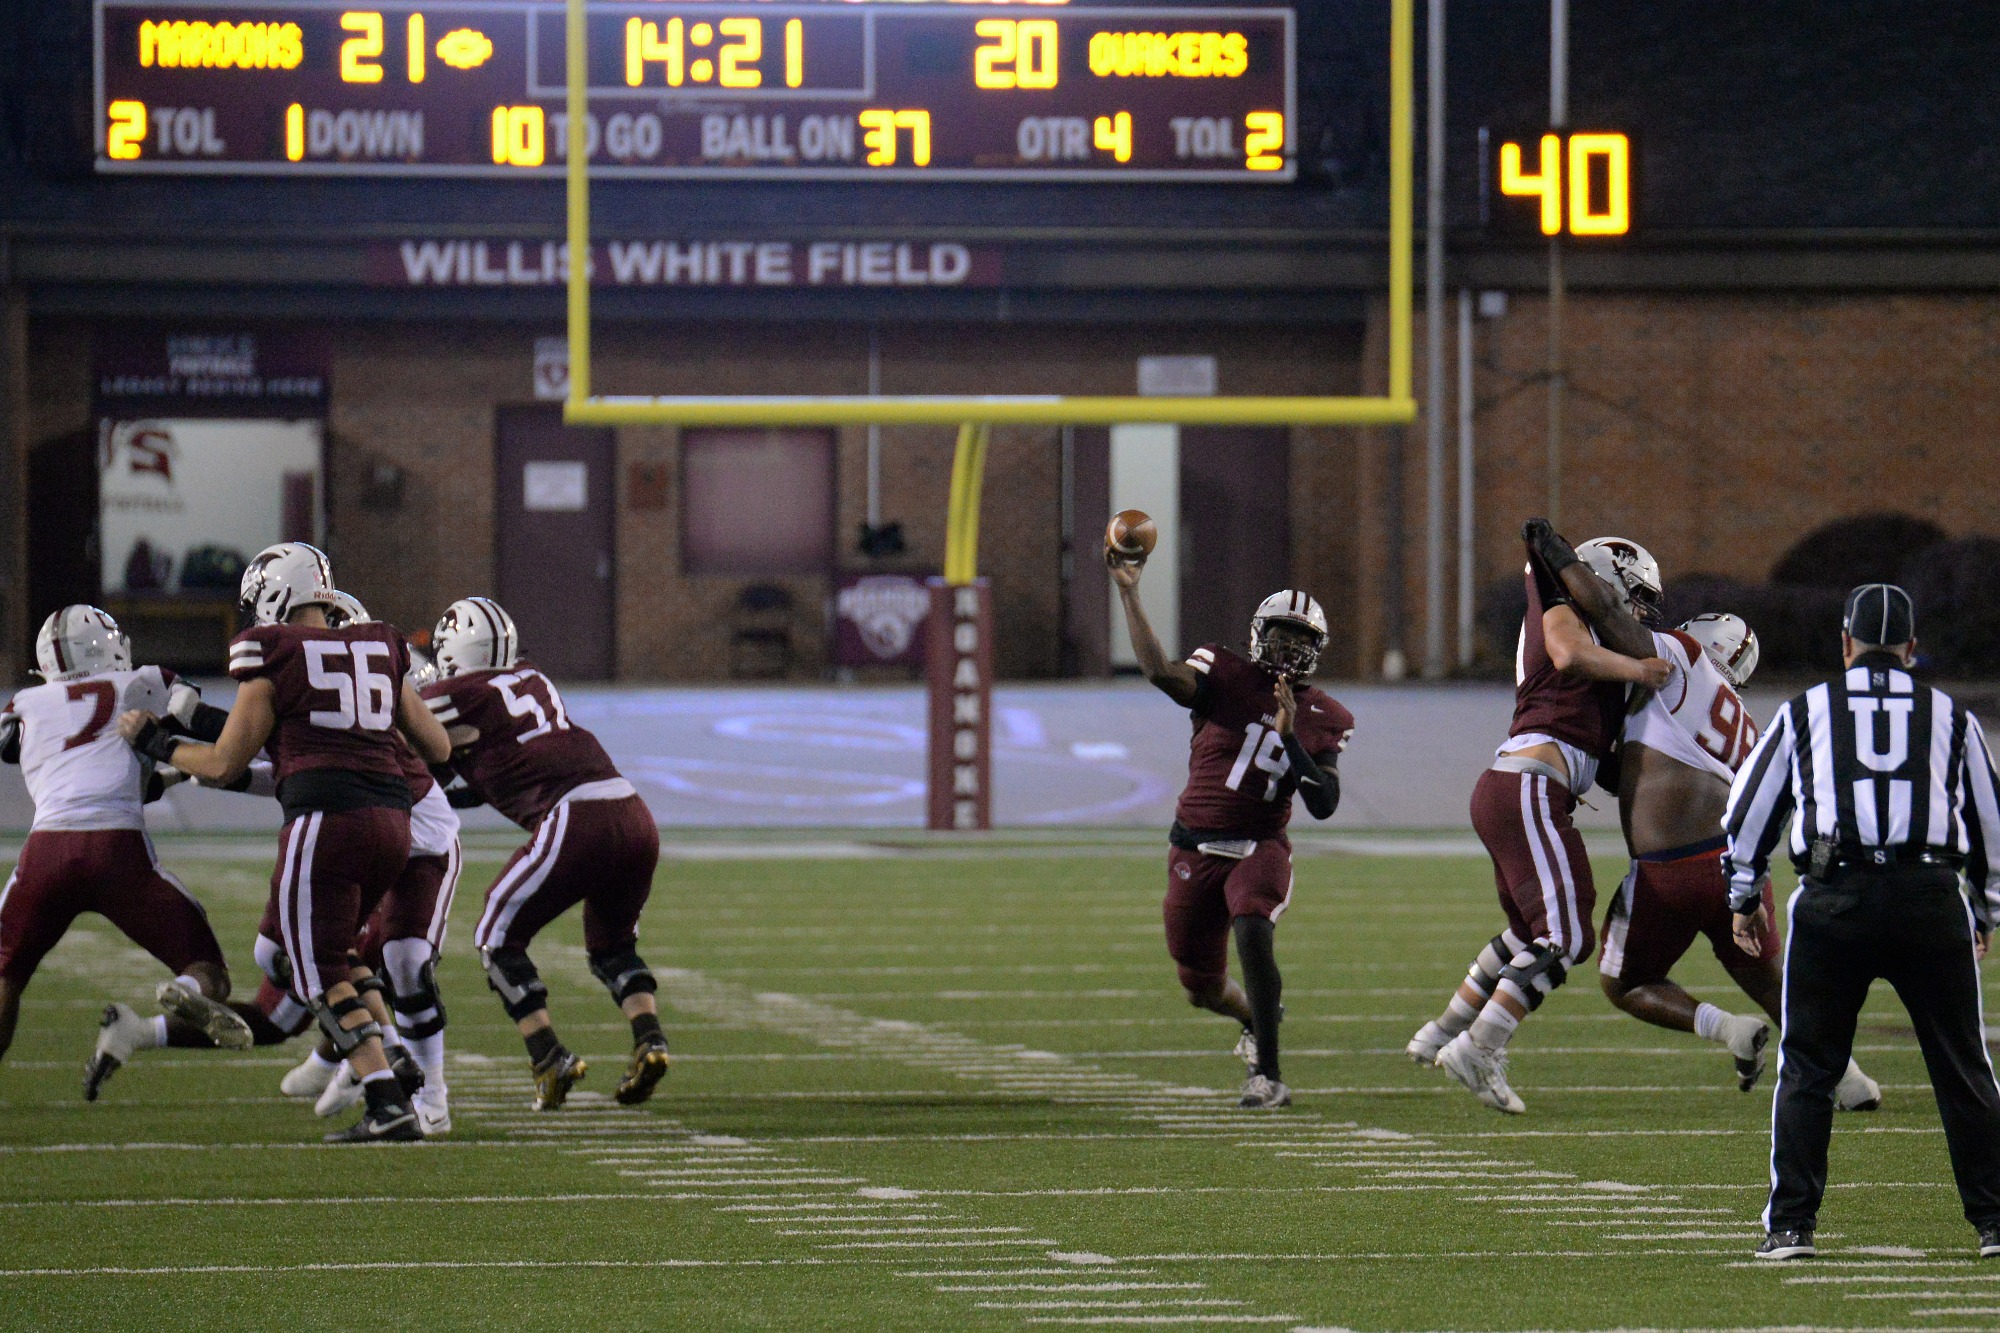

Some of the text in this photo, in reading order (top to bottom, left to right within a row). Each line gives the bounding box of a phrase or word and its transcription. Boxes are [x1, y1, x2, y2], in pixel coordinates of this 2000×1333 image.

[139, 20, 303, 70] MAROONS
[339, 11, 426, 84] 21
[625, 16, 803, 89] 14:21
[974, 18, 1059, 90] 20
[1088, 31, 1248, 78] QUAKERS
[108, 100, 225, 160] 2 TOL
[286, 103, 424, 162] 1 DOWN
[491, 106, 545, 167] 10
[606, 111, 662, 158] GO
[702, 109, 931, 167] BALL ON 37
[1093, 111, 1133, 163] 4
[1169, 111, 1284, 171] TOL 2
[1501, 134, 1629, 236] 40
[608, 243, 792, 284] WHITE
[808, 243, 971, 284] FIELD
[302, 639, 394, 731] 56
[62, 680, 116, 752] 7
[1847, 696, 1914, 772] U
[1224, 722, 1291, 803] 19
[1873, 850, 1887, 865] S
